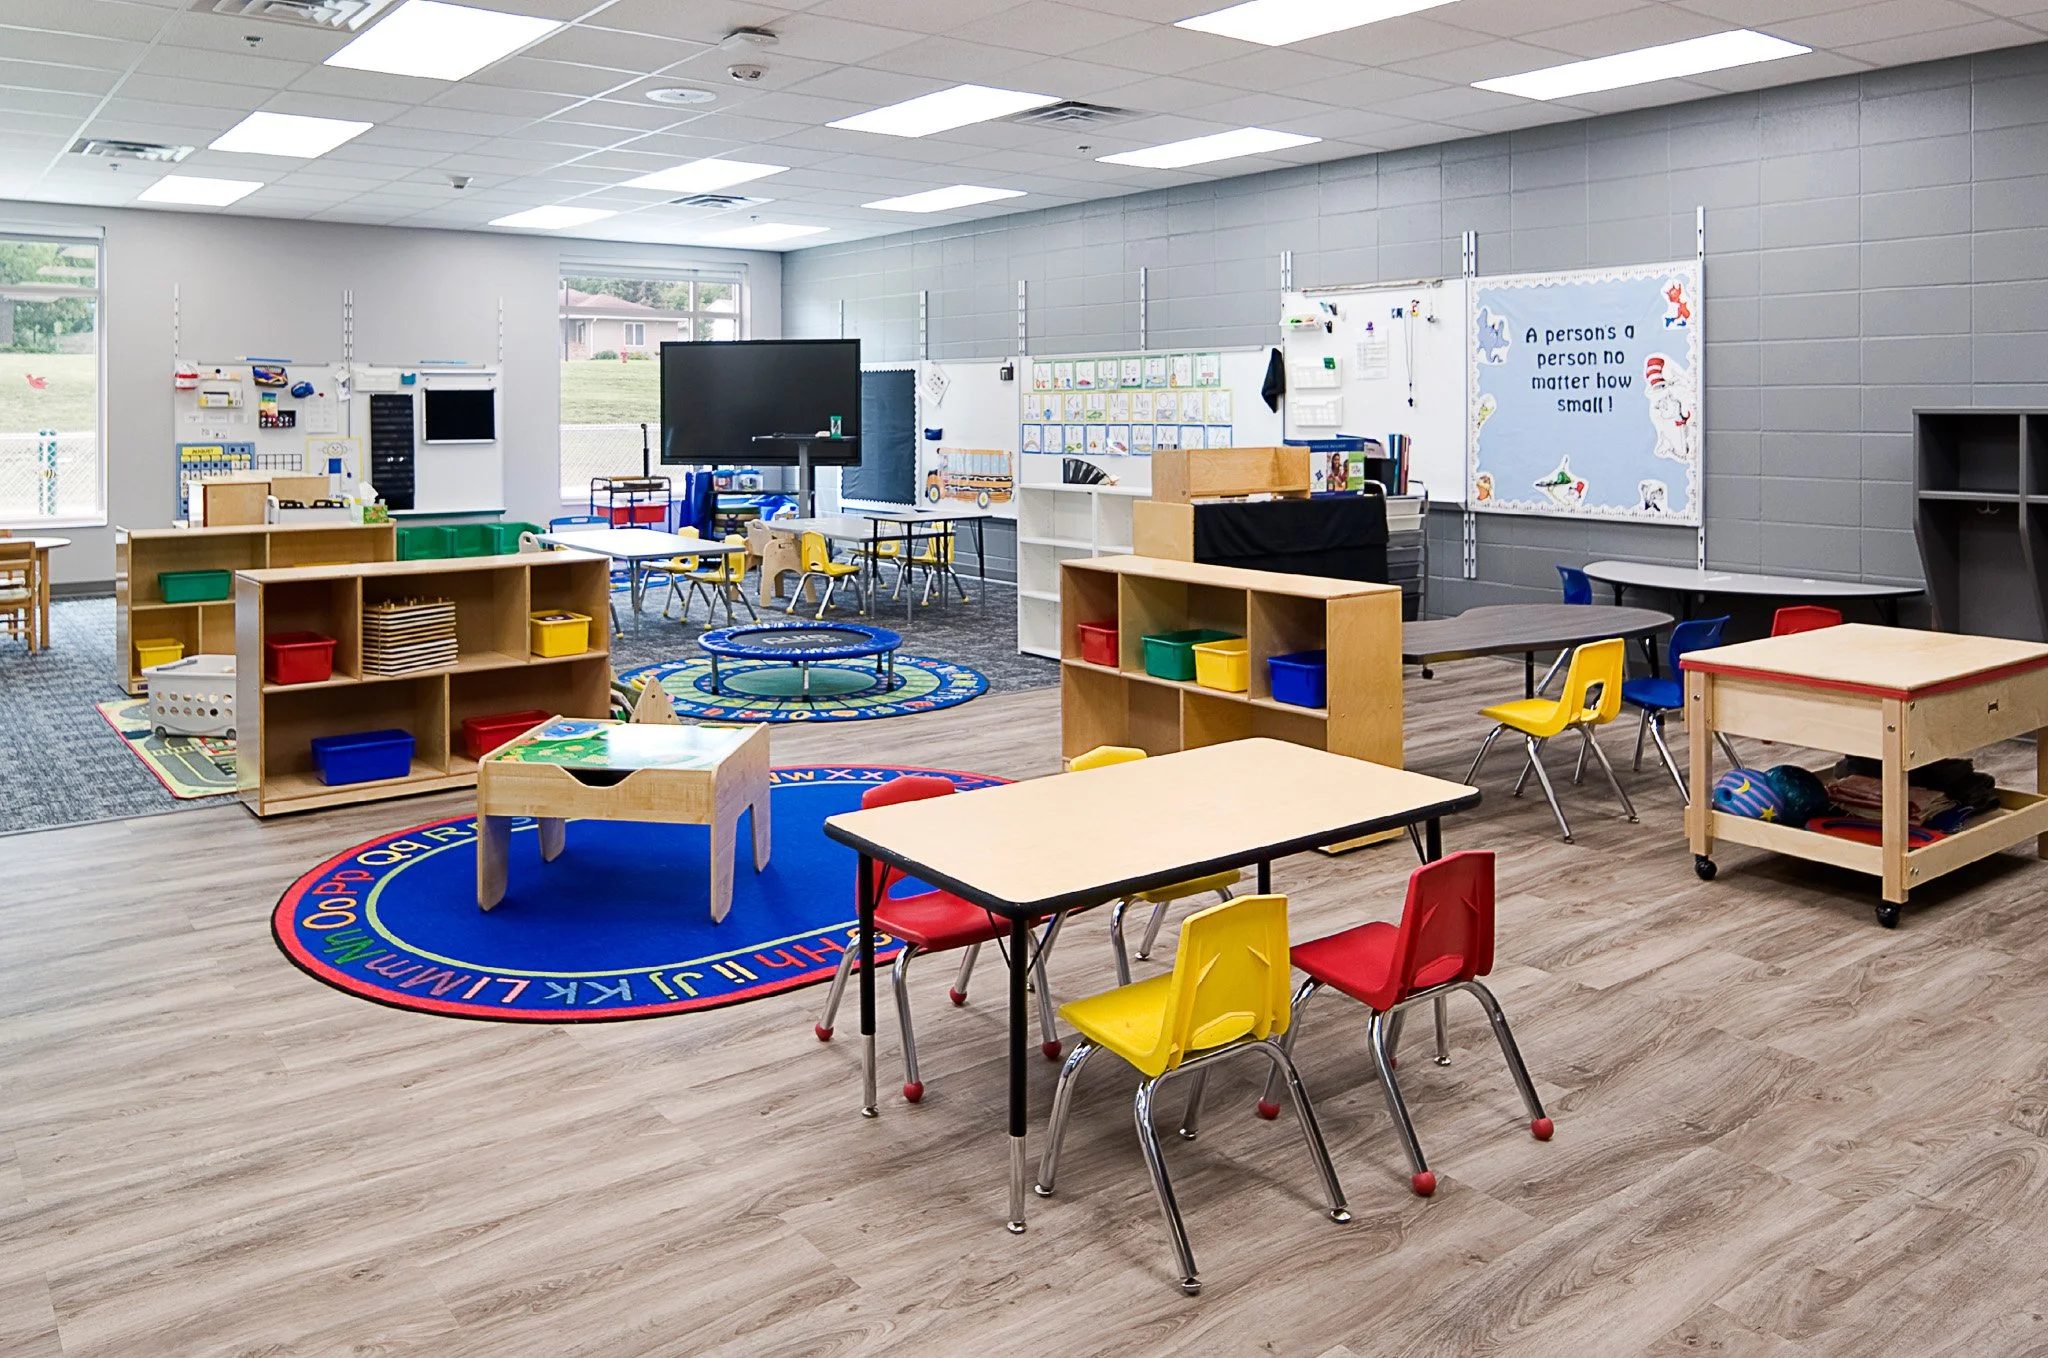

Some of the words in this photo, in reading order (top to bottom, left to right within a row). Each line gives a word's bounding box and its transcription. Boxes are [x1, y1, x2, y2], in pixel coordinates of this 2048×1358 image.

[1525, 327, 1538, 343] A
[1545, 324, 1617, 346] person's
[1624, 325, 1635, 339] a
[1537, 351, 1598, 369] person
[1603, 350, 1625, 365] no
[1531, 375, 1590, 390] matter
[1596, 372, 1632, 389] how
[1557, 397, 1603, 413] small
[823, 769, 884, 780] Xx
[356, 839, 432, 866] Qq
[310, 869, 376, 895] Pp
[323, 928, 388, 965] Nn
[755, 937, 846, 969] Hh
[364, 953, 471, 997] Mm
